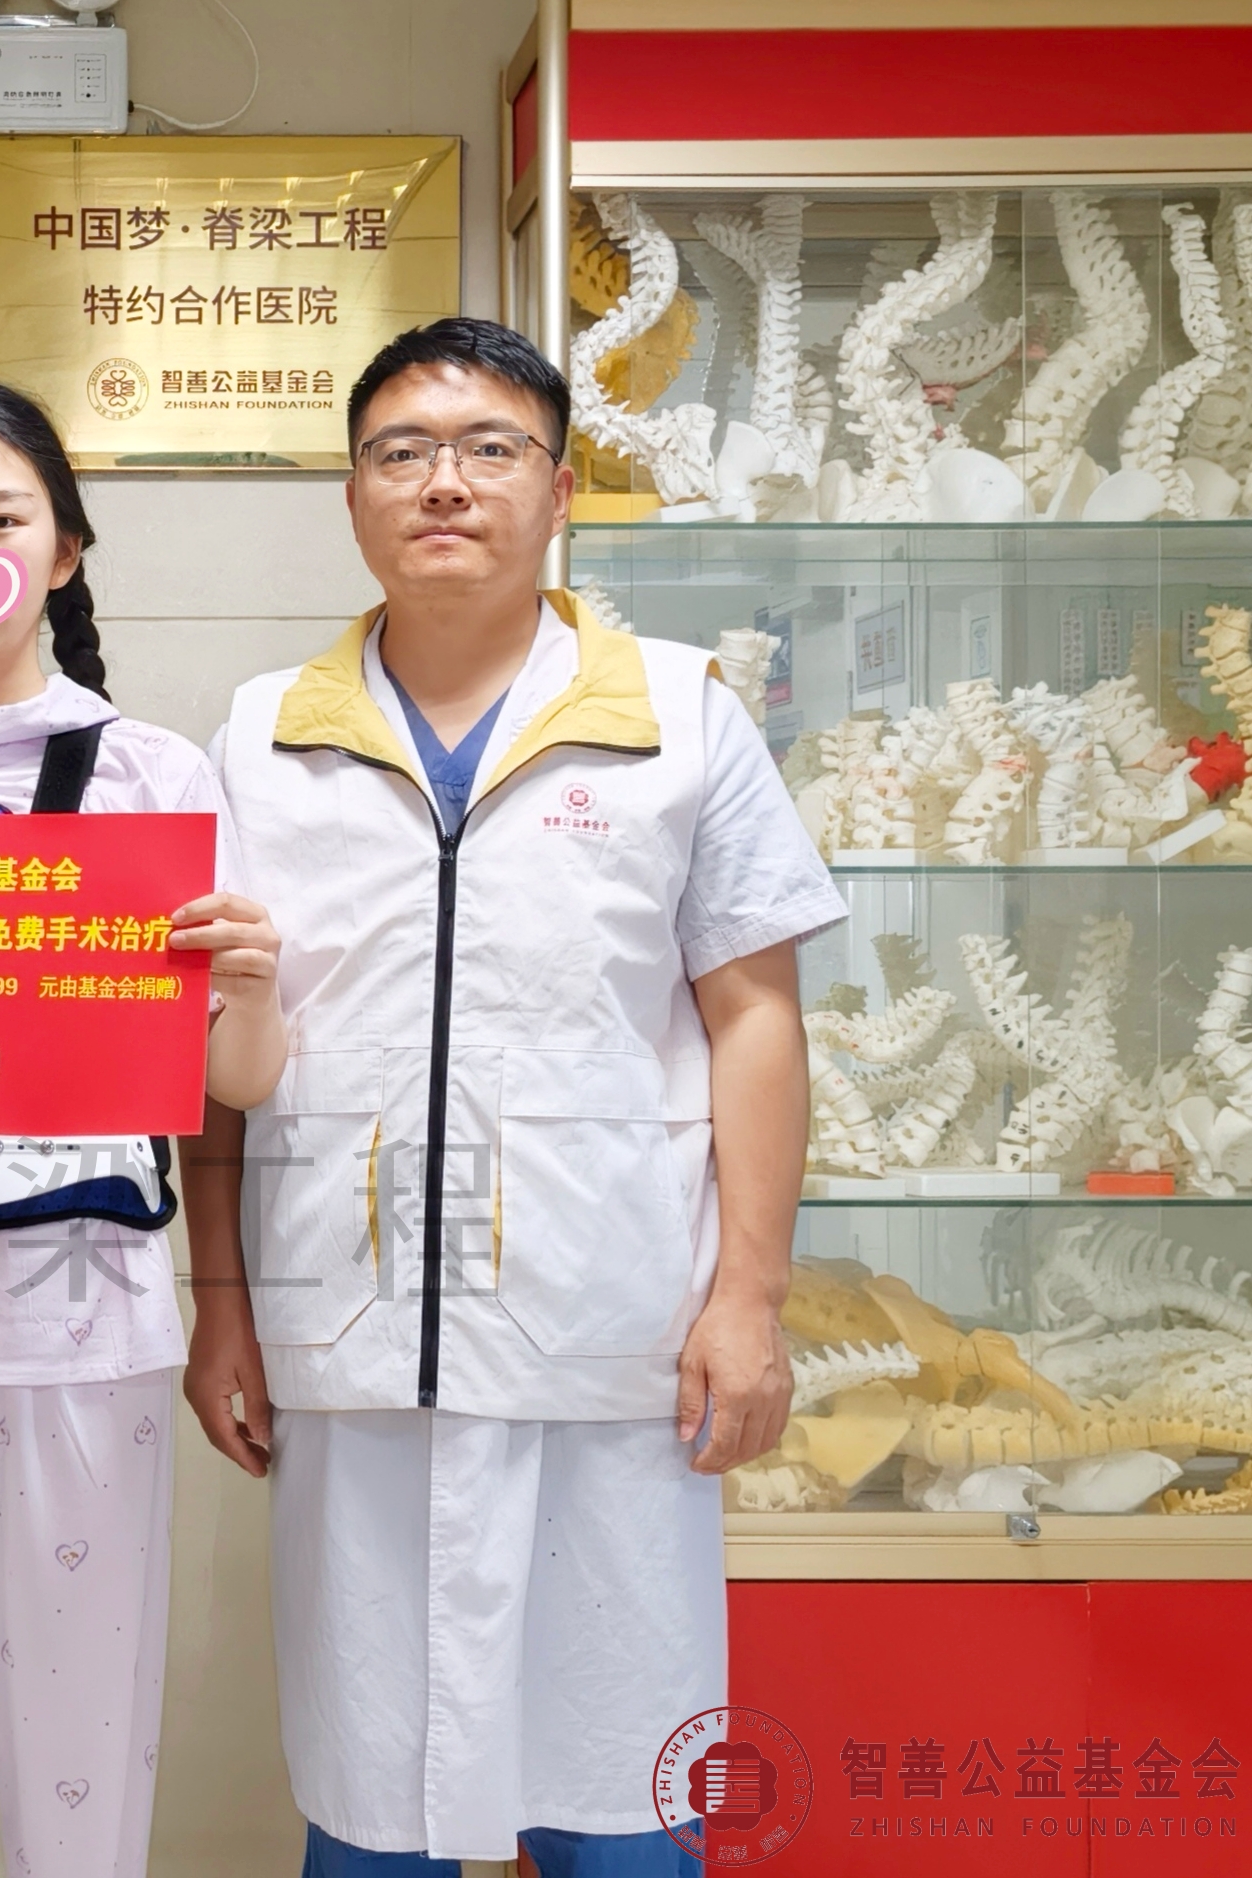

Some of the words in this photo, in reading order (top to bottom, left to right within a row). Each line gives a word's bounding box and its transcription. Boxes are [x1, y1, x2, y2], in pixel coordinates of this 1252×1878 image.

[33, 205, 388, 251] 中国梦·脊梁工程
[83, 284, 338, 326] 特约合作医院
[161, 370, 334, 393] 智善公益基金会
[164, 401, 230, 409] ZHISHAN
[236, 401, 333, 409] FOUNDATION
